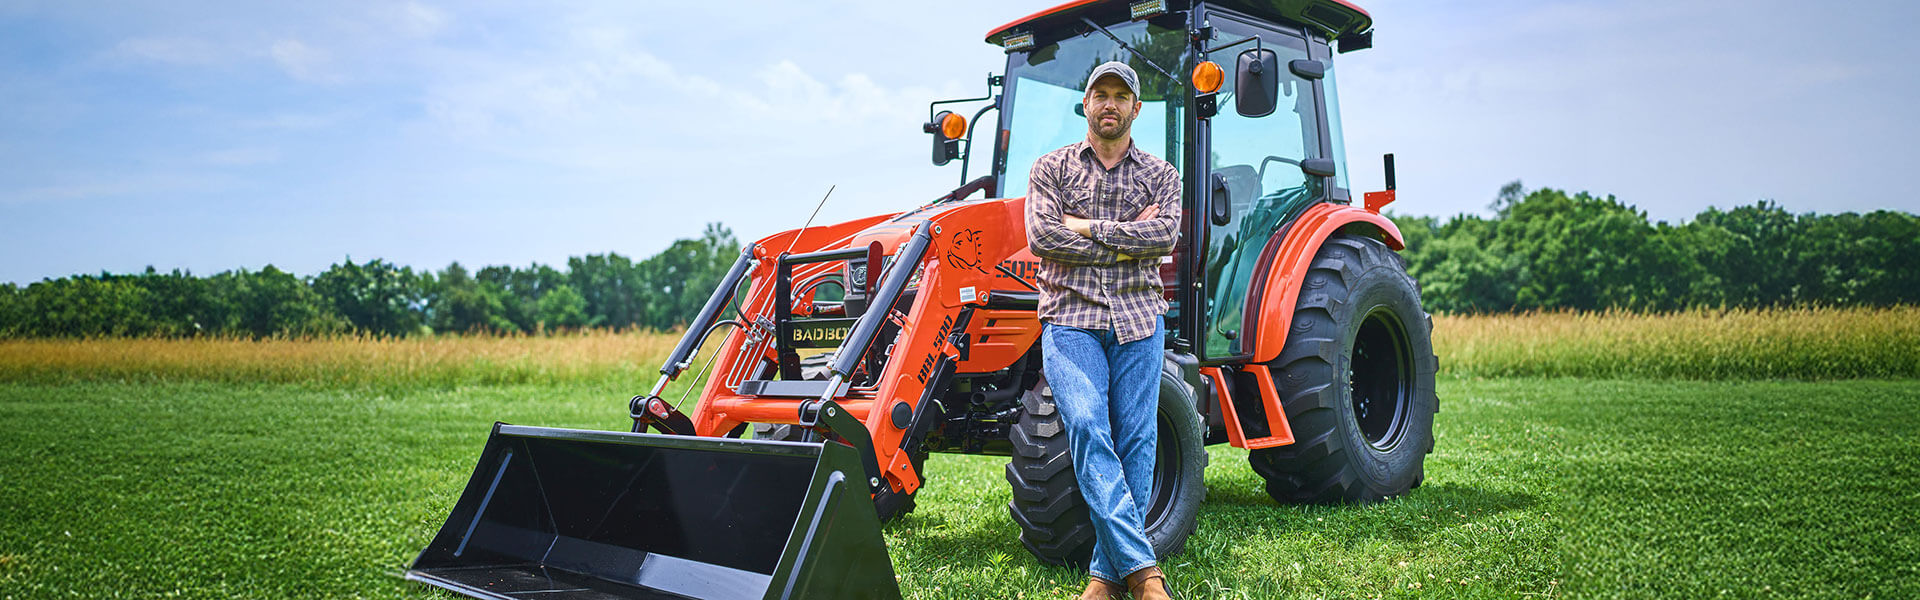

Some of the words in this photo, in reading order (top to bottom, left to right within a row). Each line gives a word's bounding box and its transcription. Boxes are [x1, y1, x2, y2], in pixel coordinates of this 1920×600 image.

[793, 326, 851, 342] BADBO
[917, 352, 938, 385] BBL
[932, 314, 953, 352] 500
